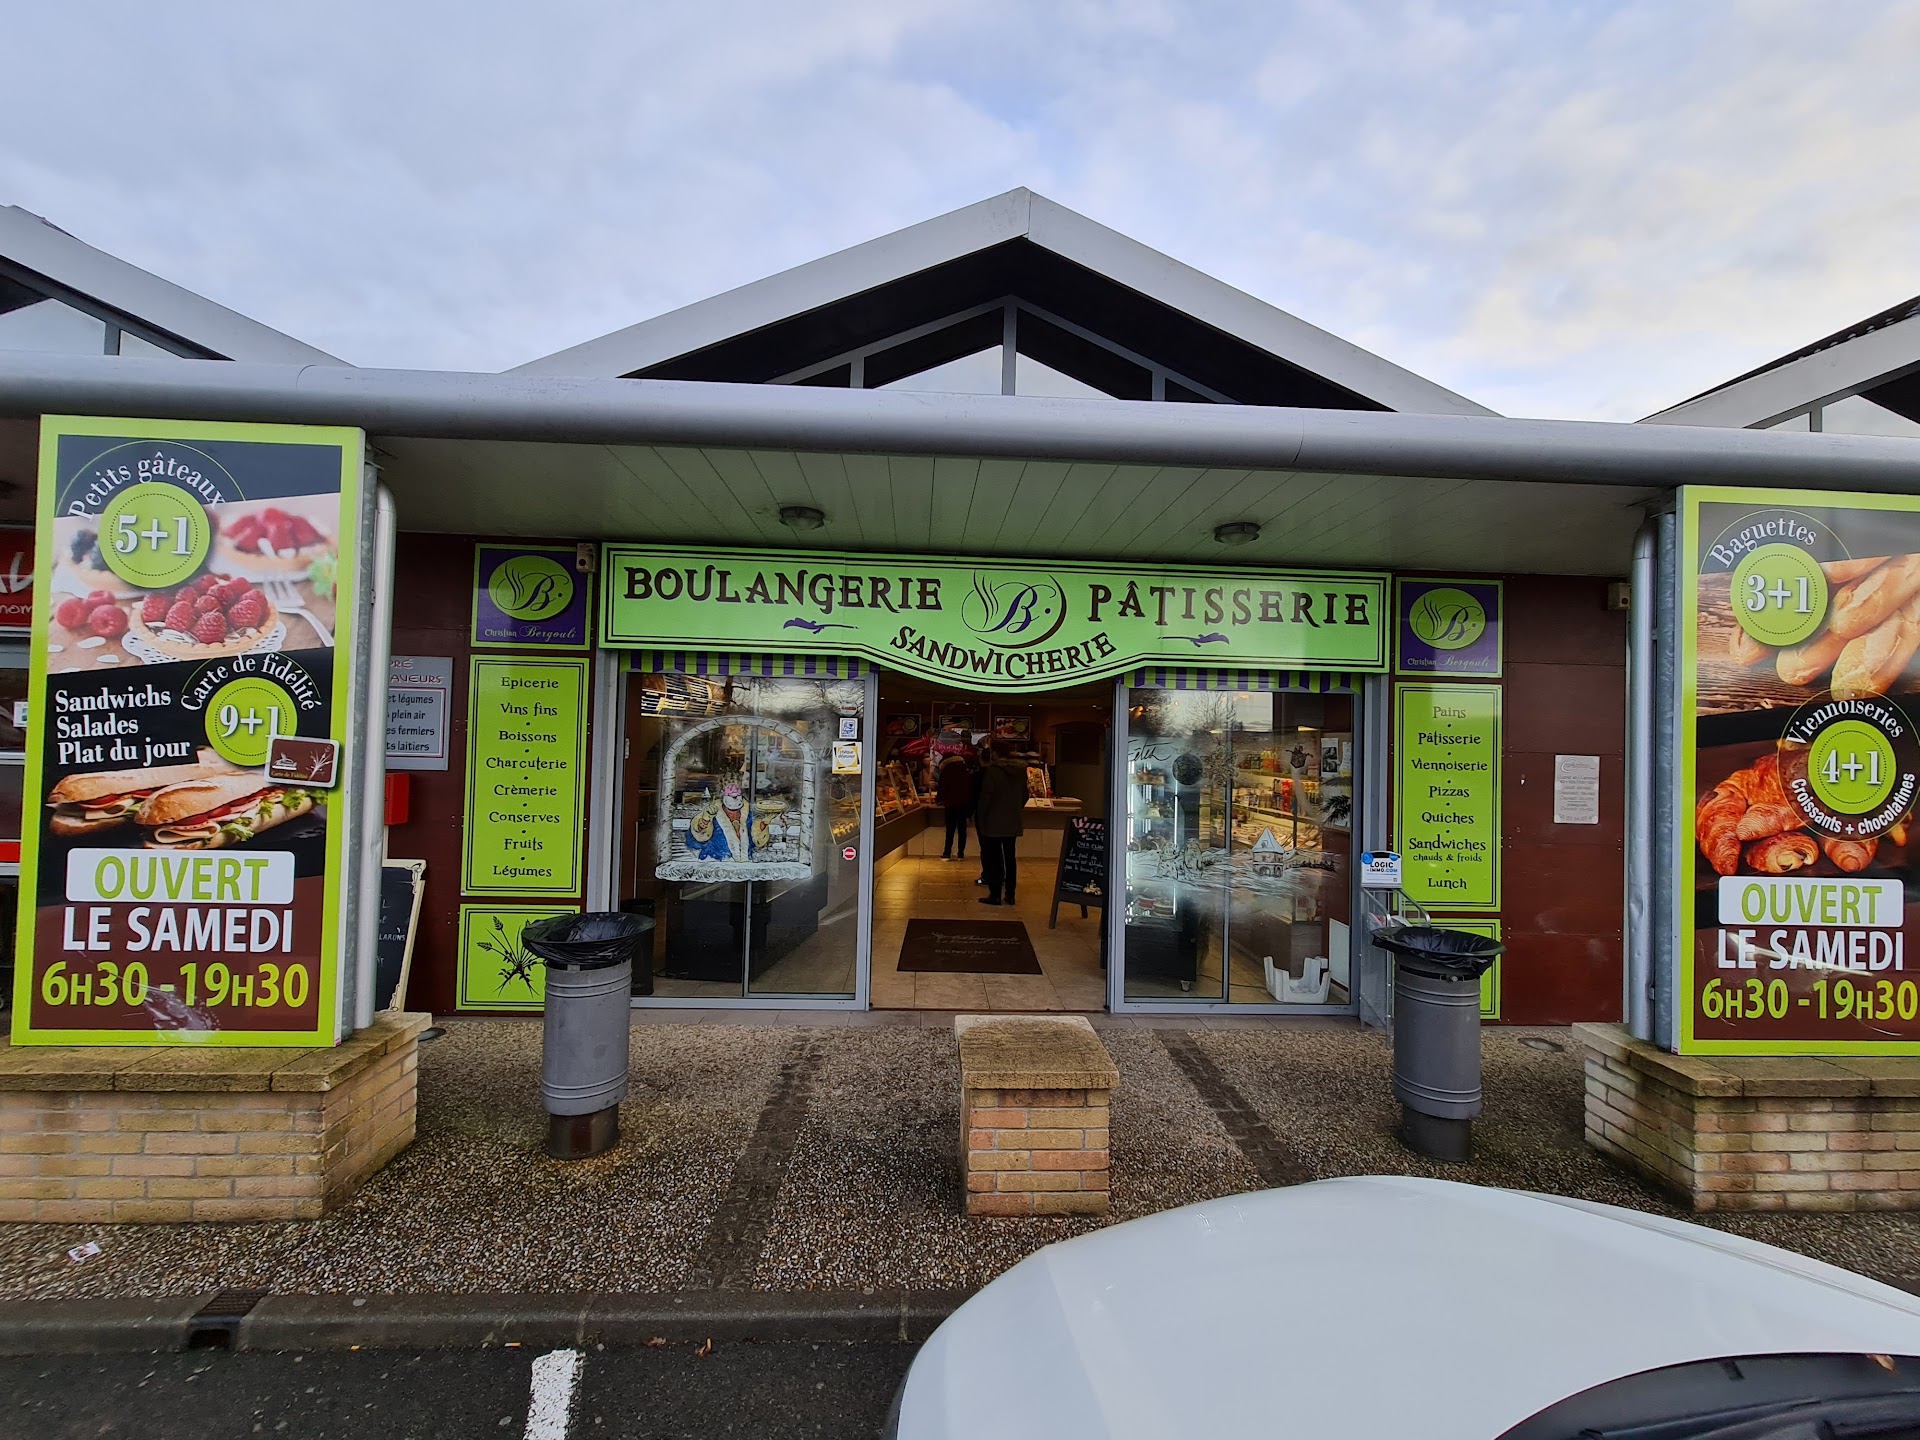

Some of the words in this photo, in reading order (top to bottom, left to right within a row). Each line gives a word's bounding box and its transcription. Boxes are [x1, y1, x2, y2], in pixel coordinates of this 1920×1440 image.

[68, 460, 131, 521] Petits
[138, 451, 225, 507] gâteaux
[115, 514, 191, 555] 5+1
[1710, 518, 1817, 568] Baguettes
[623, 565, 943, 614] BOULANGERIE
[1088, 581, 1370, 628] PÂTISSERIE
[1746, 574, 1812, 613] 3+1
[484, 628, 517, 638] Christian
[890, 625, 1117, 679] SANDWICHERIE
[1407, 657, 1437, 667] Christian
[181, 664, 228, 711] Carte
[232, 655, 256, 673] de
[262, 653, 322, 711] fidélité
[391, 674, 444, 685] AVEURS
[501, 677, 559, 689] Epicerie
[55, 684, 171, 713] Sandwichs
[398, 693, 434, 706] légumes
[391, 710, 412, 722] plein
[413, 710, 426, 720] air
[500, 702, 528, 715] Vins
[533, 702, 558, 716] fins
[1432, 706, 1466, 719] Pains
[219, 704, 282, 739] 9+1
[1786, 693, 1903, 744] Viennoiseries
[57, 714, 138, 739] Salades
[398, 725, 435, 736] fermiers
[499, 730, 557, 743] Boissons
[1418, 730, 1481, 745] Pâtisserie
[58, 742, 103, 765] Plat
[109, 740, 138, 760] du
[143, 737, 190, 767] jour
[397, 741, 430, 751] laitiers
[486, 756, 567, 770] Charcuterie
[1411, 758, 1488, 771] Viennoiserie
[1822, 749, 1882, 785] 4+1
[494, 784, 557, 796] Crèmerie
[1429, 785, 1470, 798] Pizzas
[1791, 778, 1842, 834] Croissants
[1857, 773, 1915, 835] chocolatines
[489, 811, 560, 823] Conserves
[1422, 811, 1474, 825] Quiches
[504, 837, 543, 851] Fruits
[1409, 834, 1486, 851] Sandwiches
[1413, 853, 1443, 861] chauds
[1457, 852, 1482, 863] froids
[95, 855, 269, 901] OUVERT
[493, 866, 552, 877] Légumes
[1428, 877, 1467, 889] Lunch
[1741, 883, 1882, 924] OUVERT
[63, 906, 112, 951] LE
[126, 906, 293, 952] SAMEDI
[1718, 929, 1756, 969] LE
[1769, 929, 1904, 971] SAMEDI
